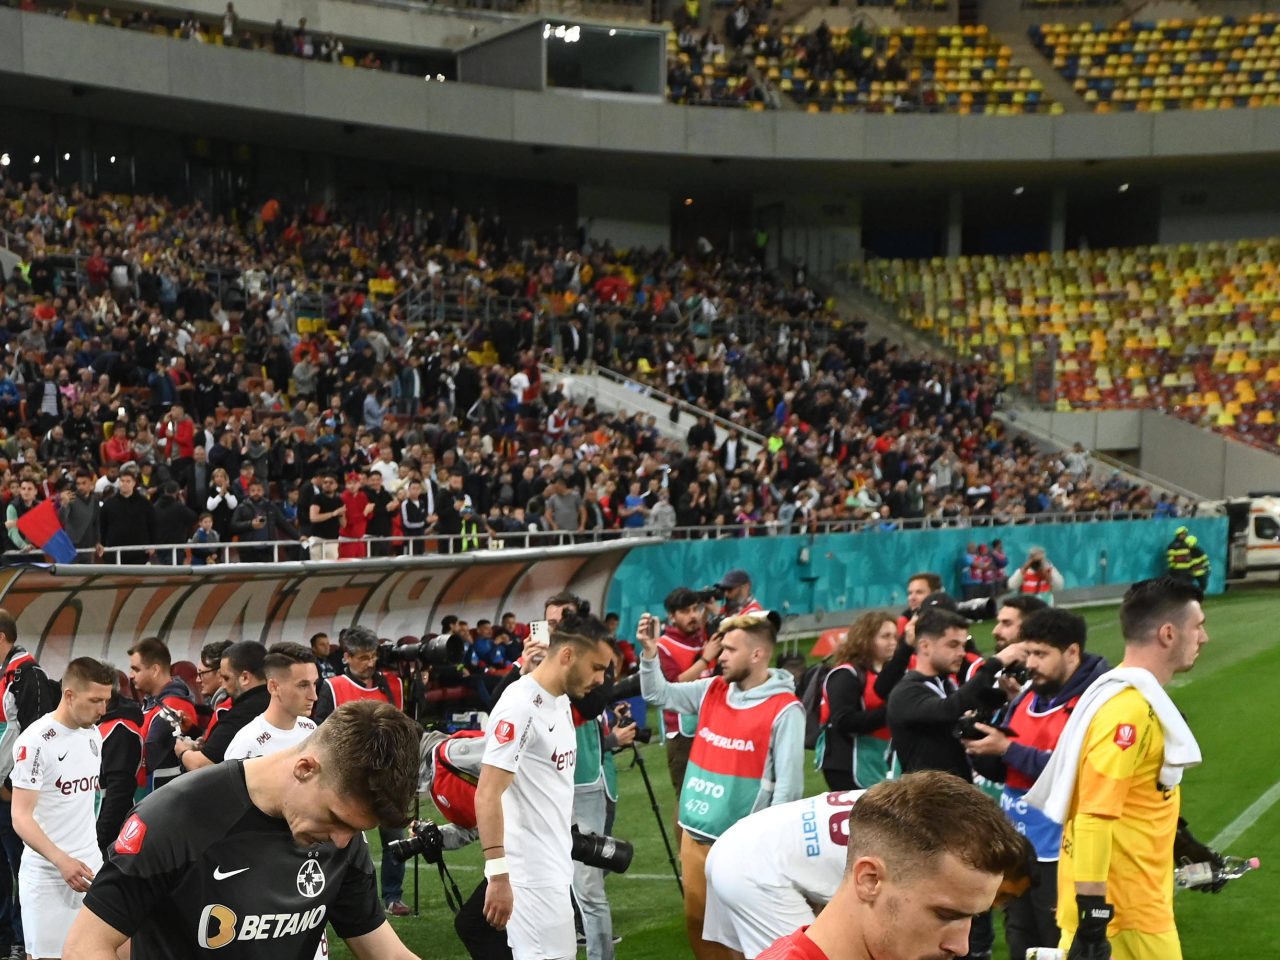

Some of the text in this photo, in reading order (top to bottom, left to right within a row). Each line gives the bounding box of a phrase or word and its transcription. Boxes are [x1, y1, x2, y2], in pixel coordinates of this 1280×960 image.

[686, 776, 725, 799] FOTO
[684, 800, 710, 816] 479
[237, 904, 327, 942] BETANO
